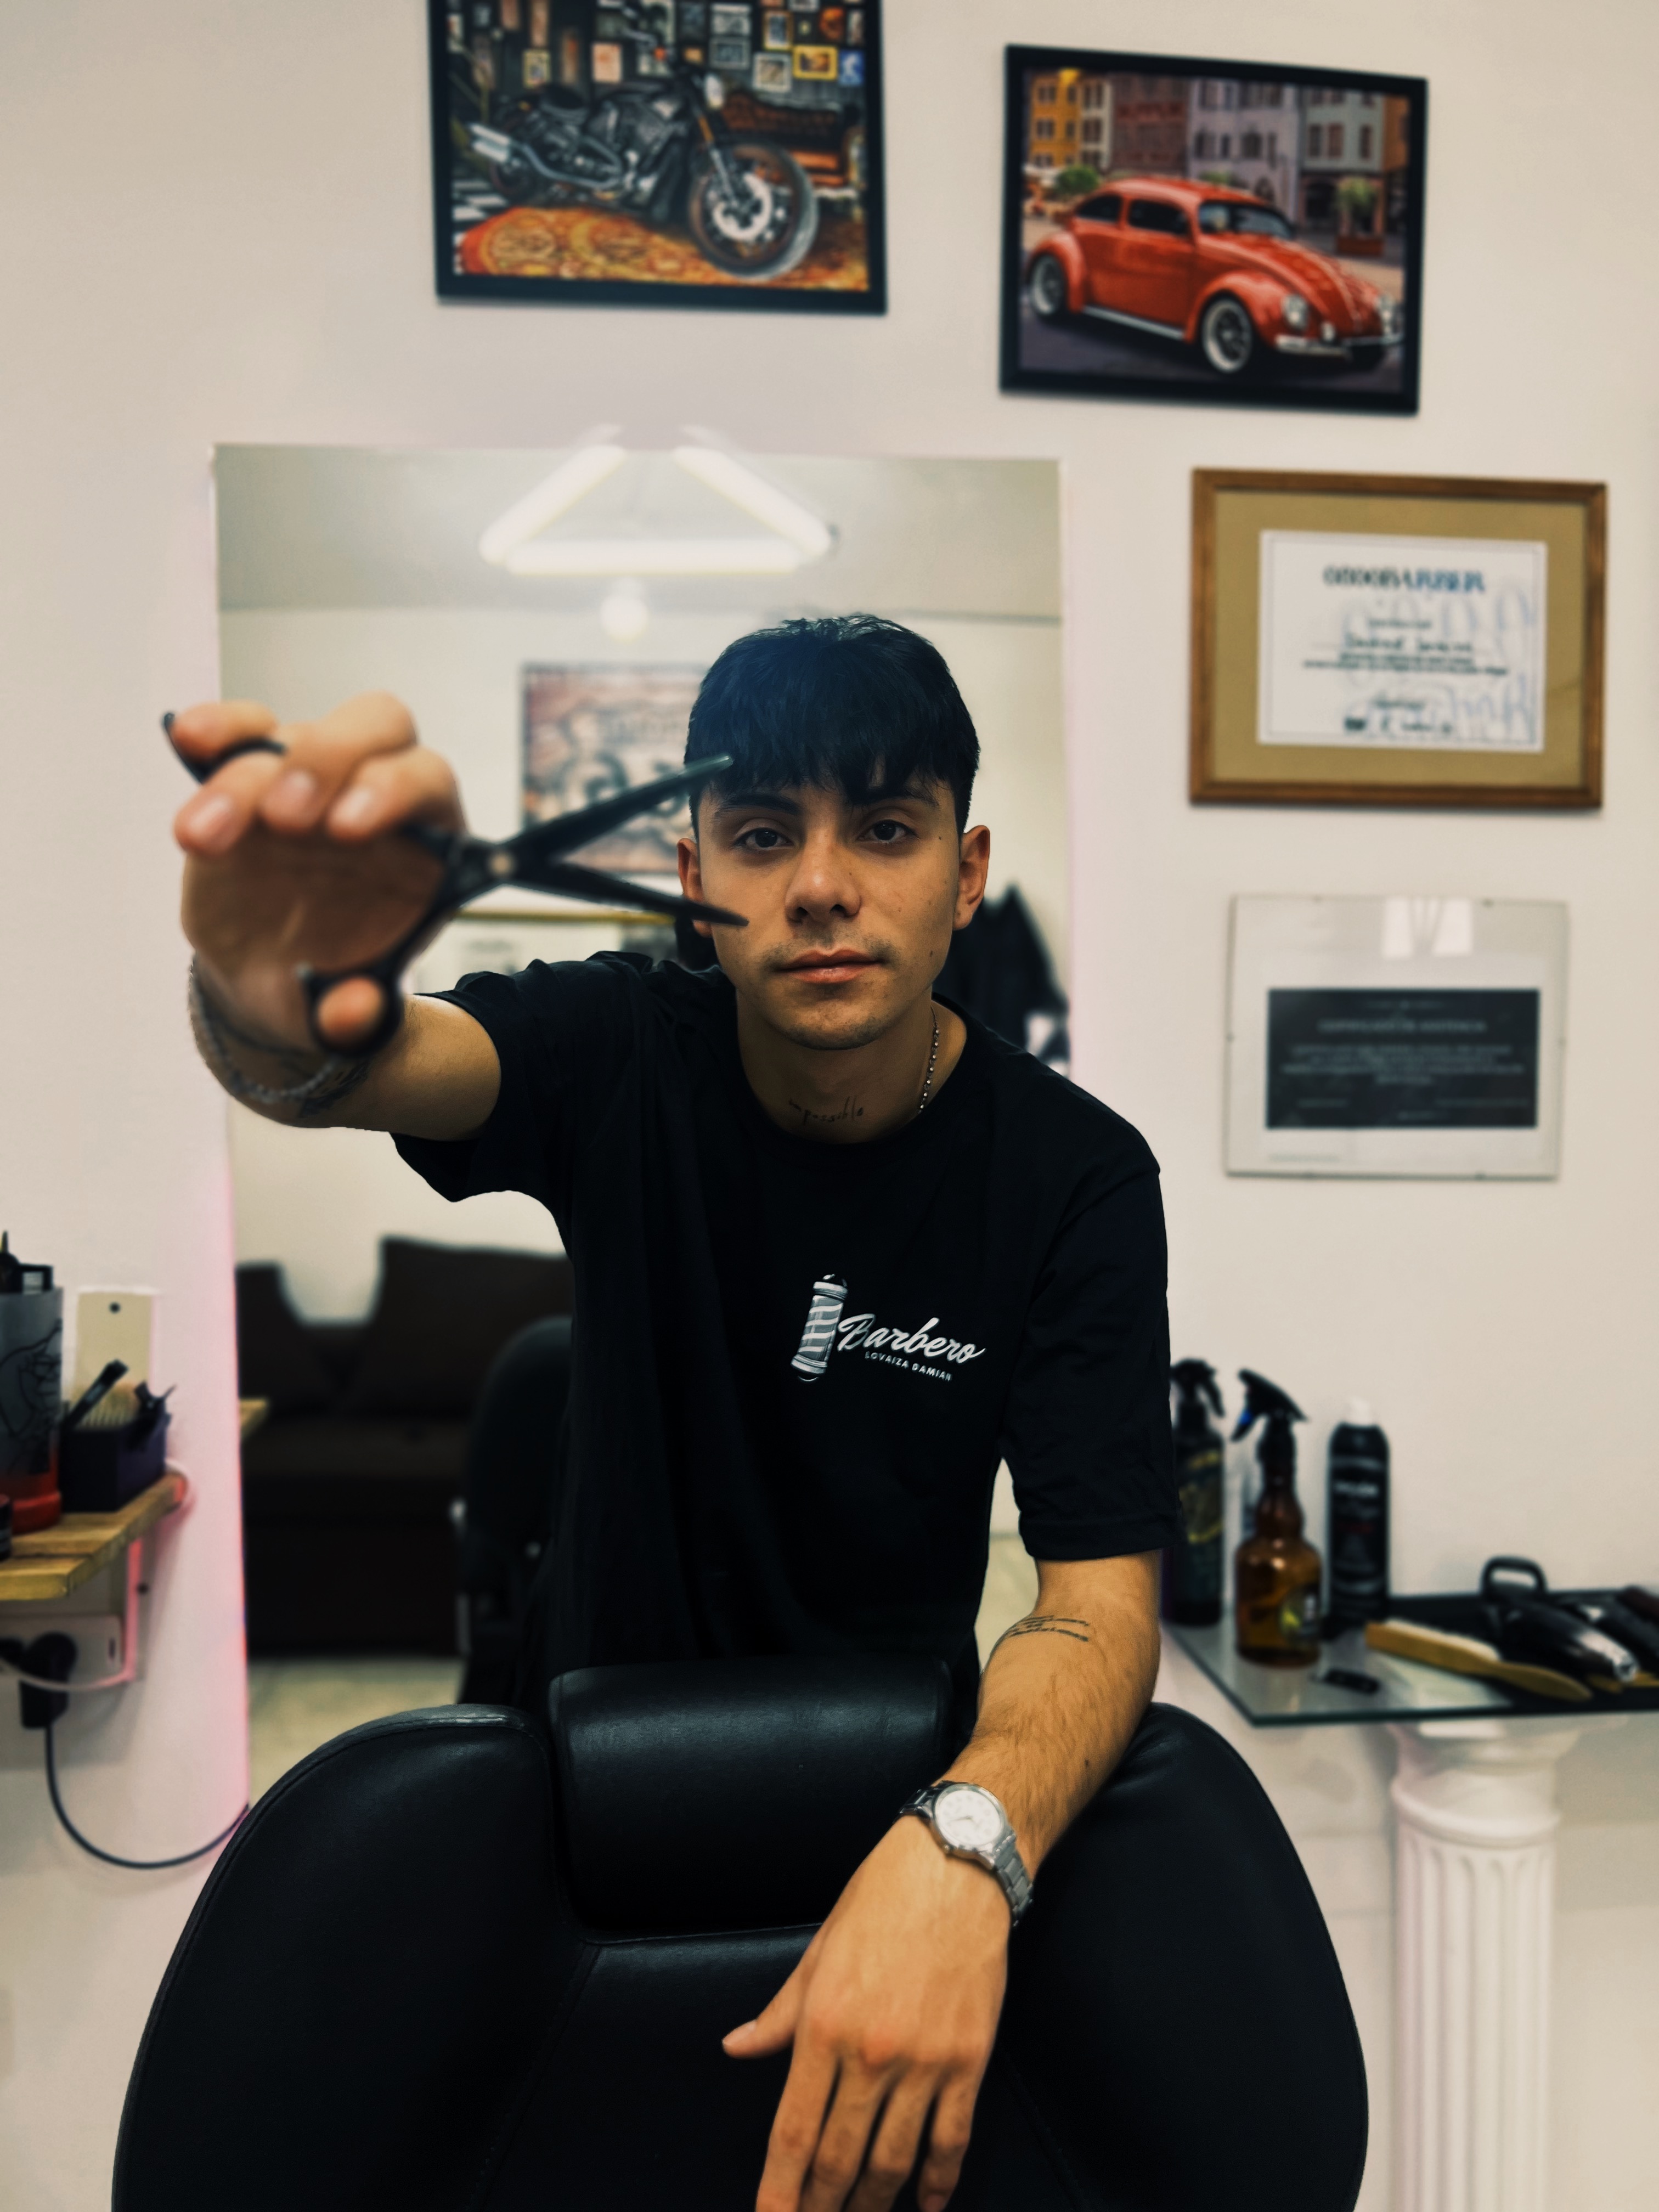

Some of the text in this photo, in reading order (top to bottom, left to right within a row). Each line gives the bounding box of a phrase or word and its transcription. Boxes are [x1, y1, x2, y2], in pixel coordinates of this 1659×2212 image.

[837, 1313, 986, 1364] Barbero
[865, 1351, 952, 1382] LOVAIZA DAMIAN
